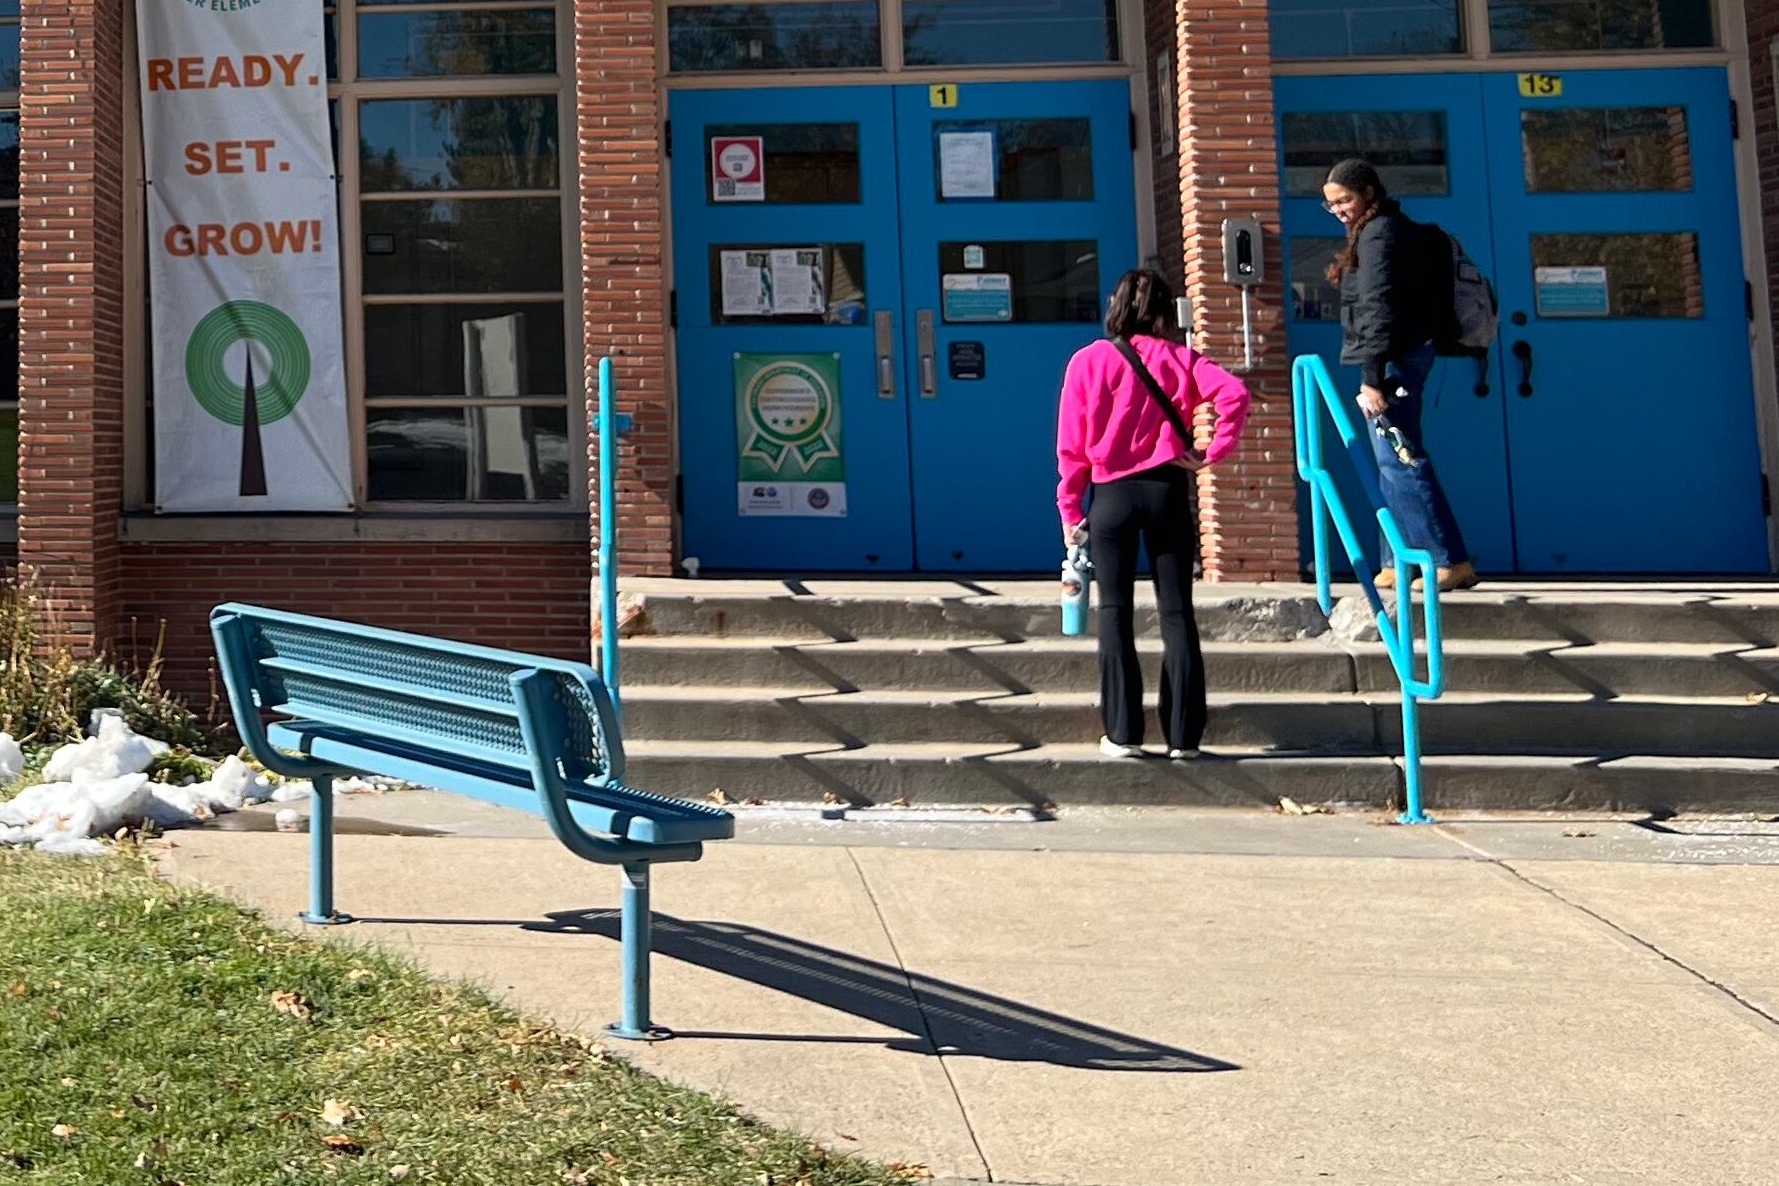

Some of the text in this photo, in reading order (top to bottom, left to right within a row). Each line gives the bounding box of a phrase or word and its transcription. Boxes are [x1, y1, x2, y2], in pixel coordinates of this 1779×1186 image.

[147, 53, 320, 93] READY.
[1524, 74, 1555, 94] 13
[936, 86, 948, 106] 1
[183, 139, 291, 176] SET.
[163, 219, 323, 258] GROW!
